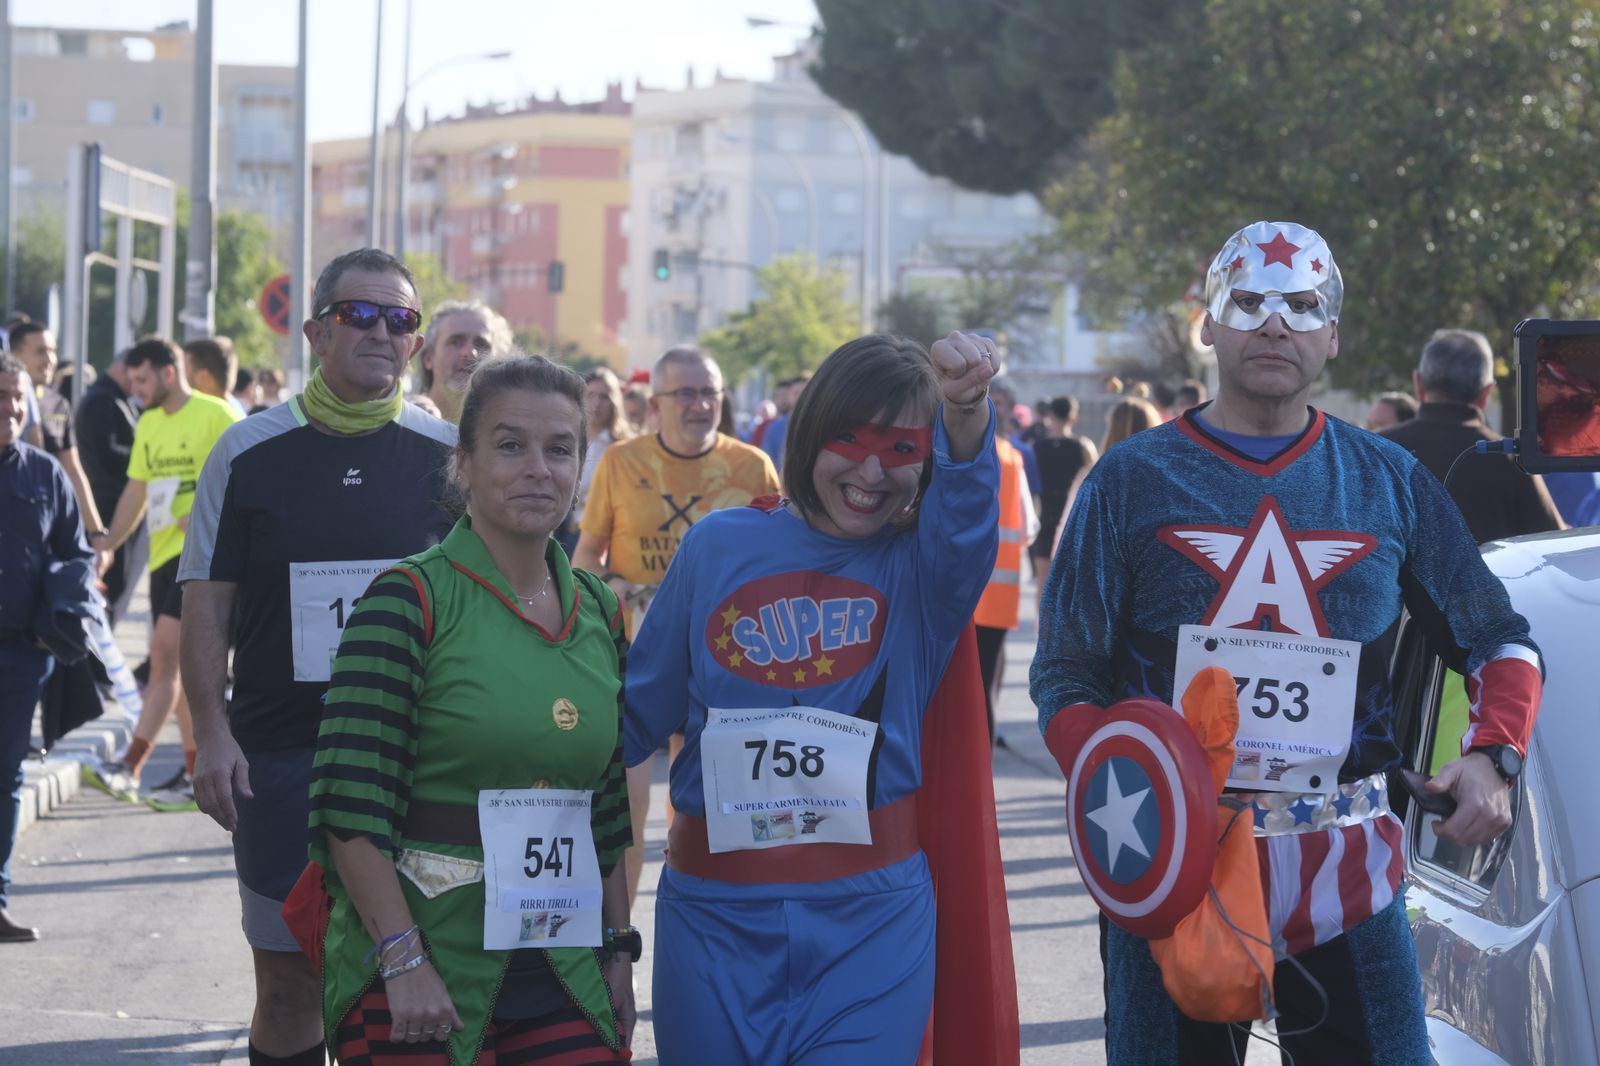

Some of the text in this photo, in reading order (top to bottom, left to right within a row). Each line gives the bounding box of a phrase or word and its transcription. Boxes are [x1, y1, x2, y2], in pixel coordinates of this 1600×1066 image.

[343, 477, 362, 486] ipso
[328, 567, 372, 576] SILVESTRE
[1209, 507, 1321, 636] A
[732, 595, 878, 666] SUPER
[1228, 637, 1286, 650] SILVESTRE
[1287, 643, 1351, 658] CORDOBESA
[806, 715, 868, 738] CORDOBESA
[1236, 739, 1333, 756] CORONEL AMÉRICA
[744, 739, 825, 780] 758
[504, 799, 523, 807] SAN
[523, 798, 562, 807] SILVESTRE
[733, 799, 848, 812] SUPER CARMEN LA FATA
[523, 836, 574, 879] 547
[519, 898, 579, 910] RIRRI TIRILLA
